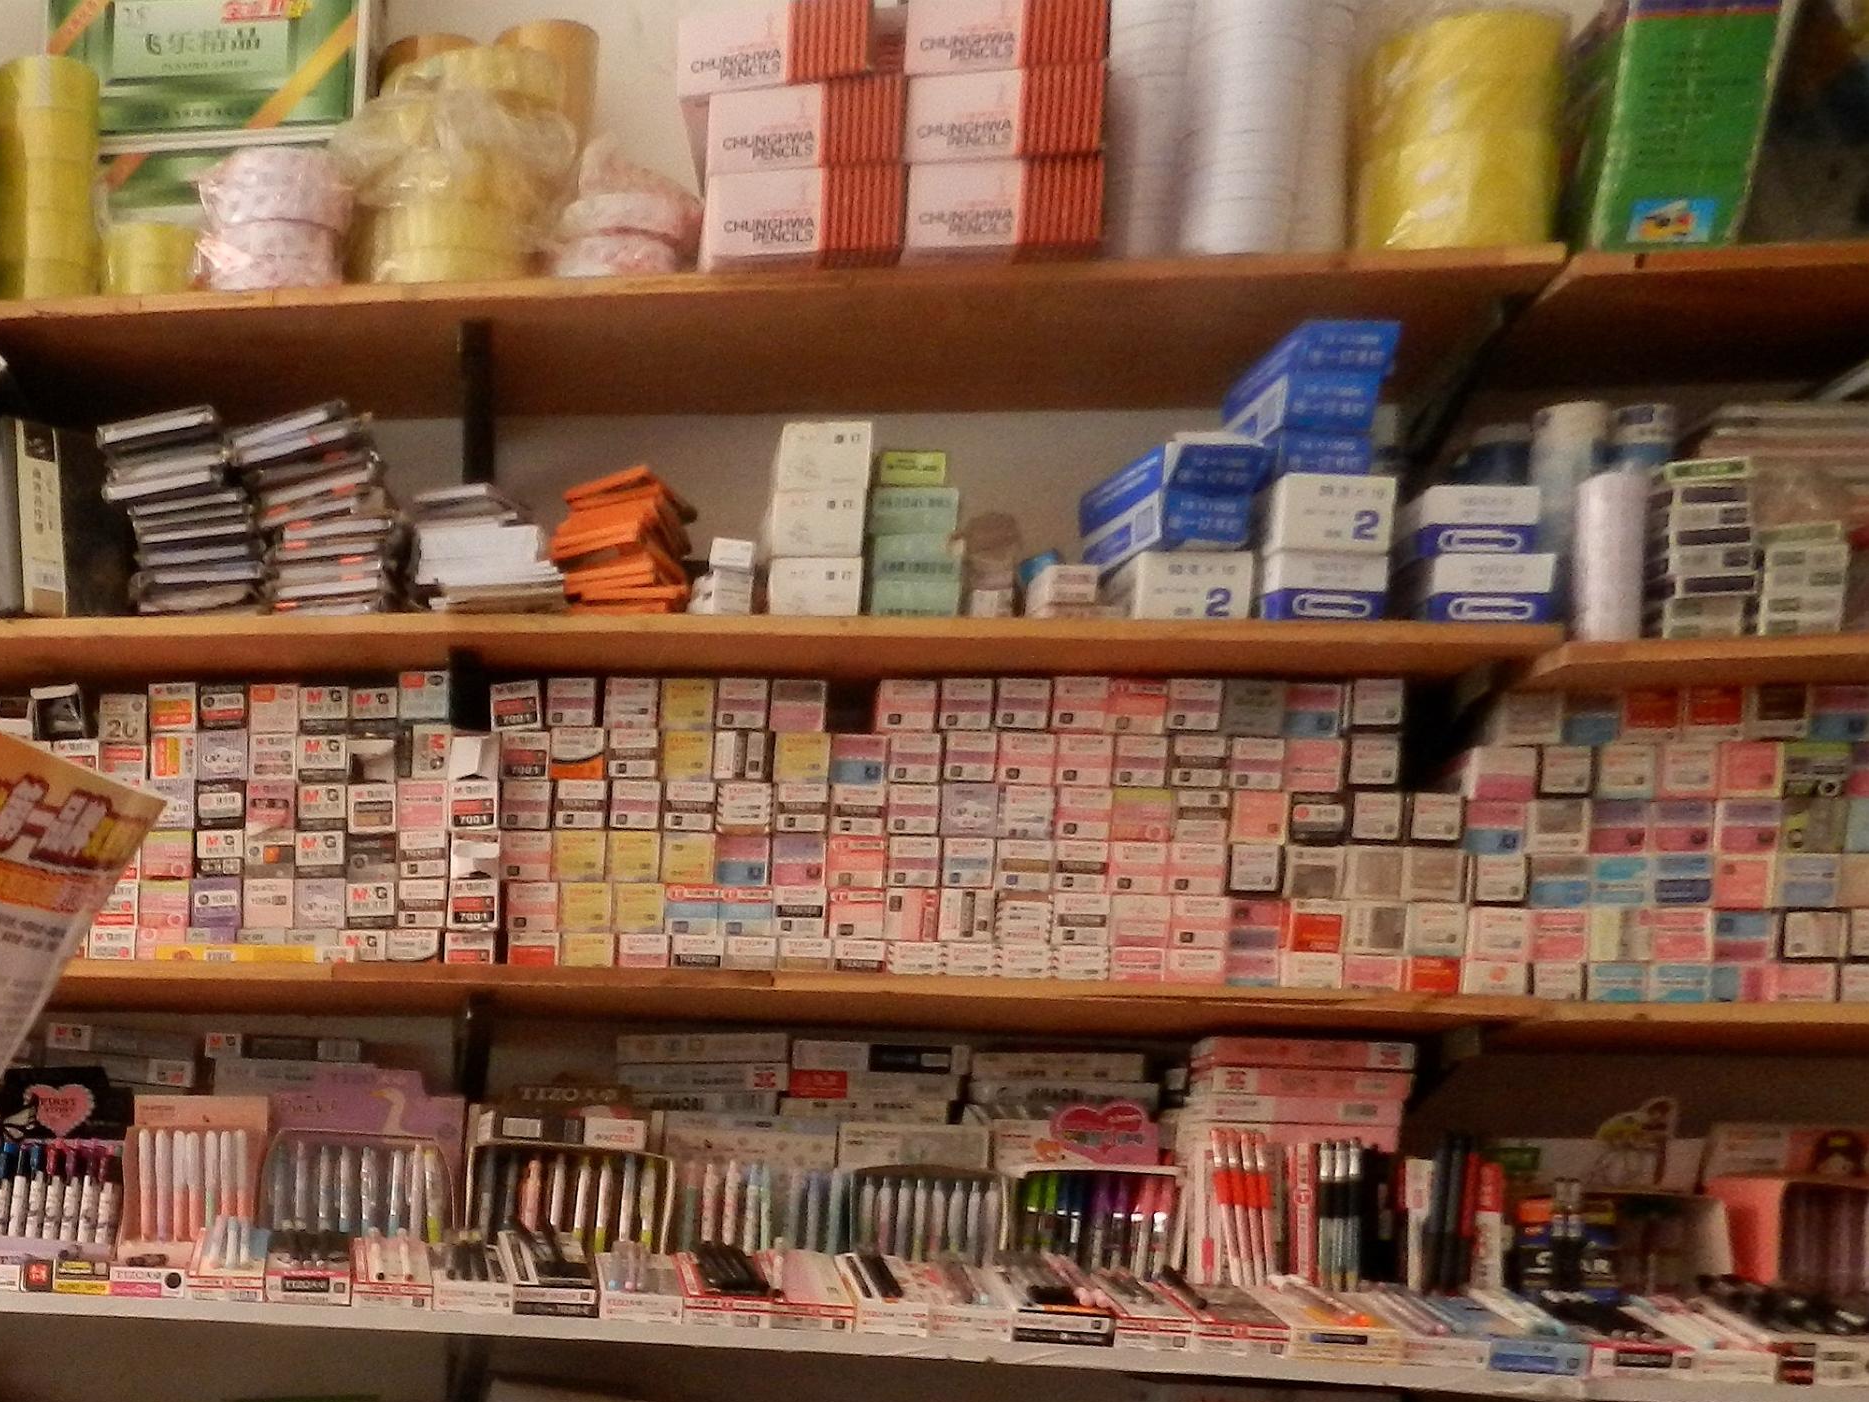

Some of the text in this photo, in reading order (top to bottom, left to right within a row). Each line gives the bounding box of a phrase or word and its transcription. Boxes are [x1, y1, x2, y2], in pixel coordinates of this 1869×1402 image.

[920, 32, 1015, 52] CHUNGHWA
[950, 42, 1014, 61] PENCILS
[691, 49, 781, 74] CHUNGHWA
[720, 61, 780, 81] PENCILS
[917, 119, 1012, 140] CHUNGHWA
[947, 129, 1011, 149] PENCILS
[722, 130, 814, 152] CHUNGHWA
[752, 142, 814, 161] PENCILS
[723, 215, 815, 235] CHUNGHWA
[919, 209, 1014, 227] CHUNGHWA
[947, 218, 1013, 237] PENCILS
[752, 226, 814, 244] PENCILS
[1352, 510, 1380, 540] 2
[1205, 587, 1233, 617] 2
